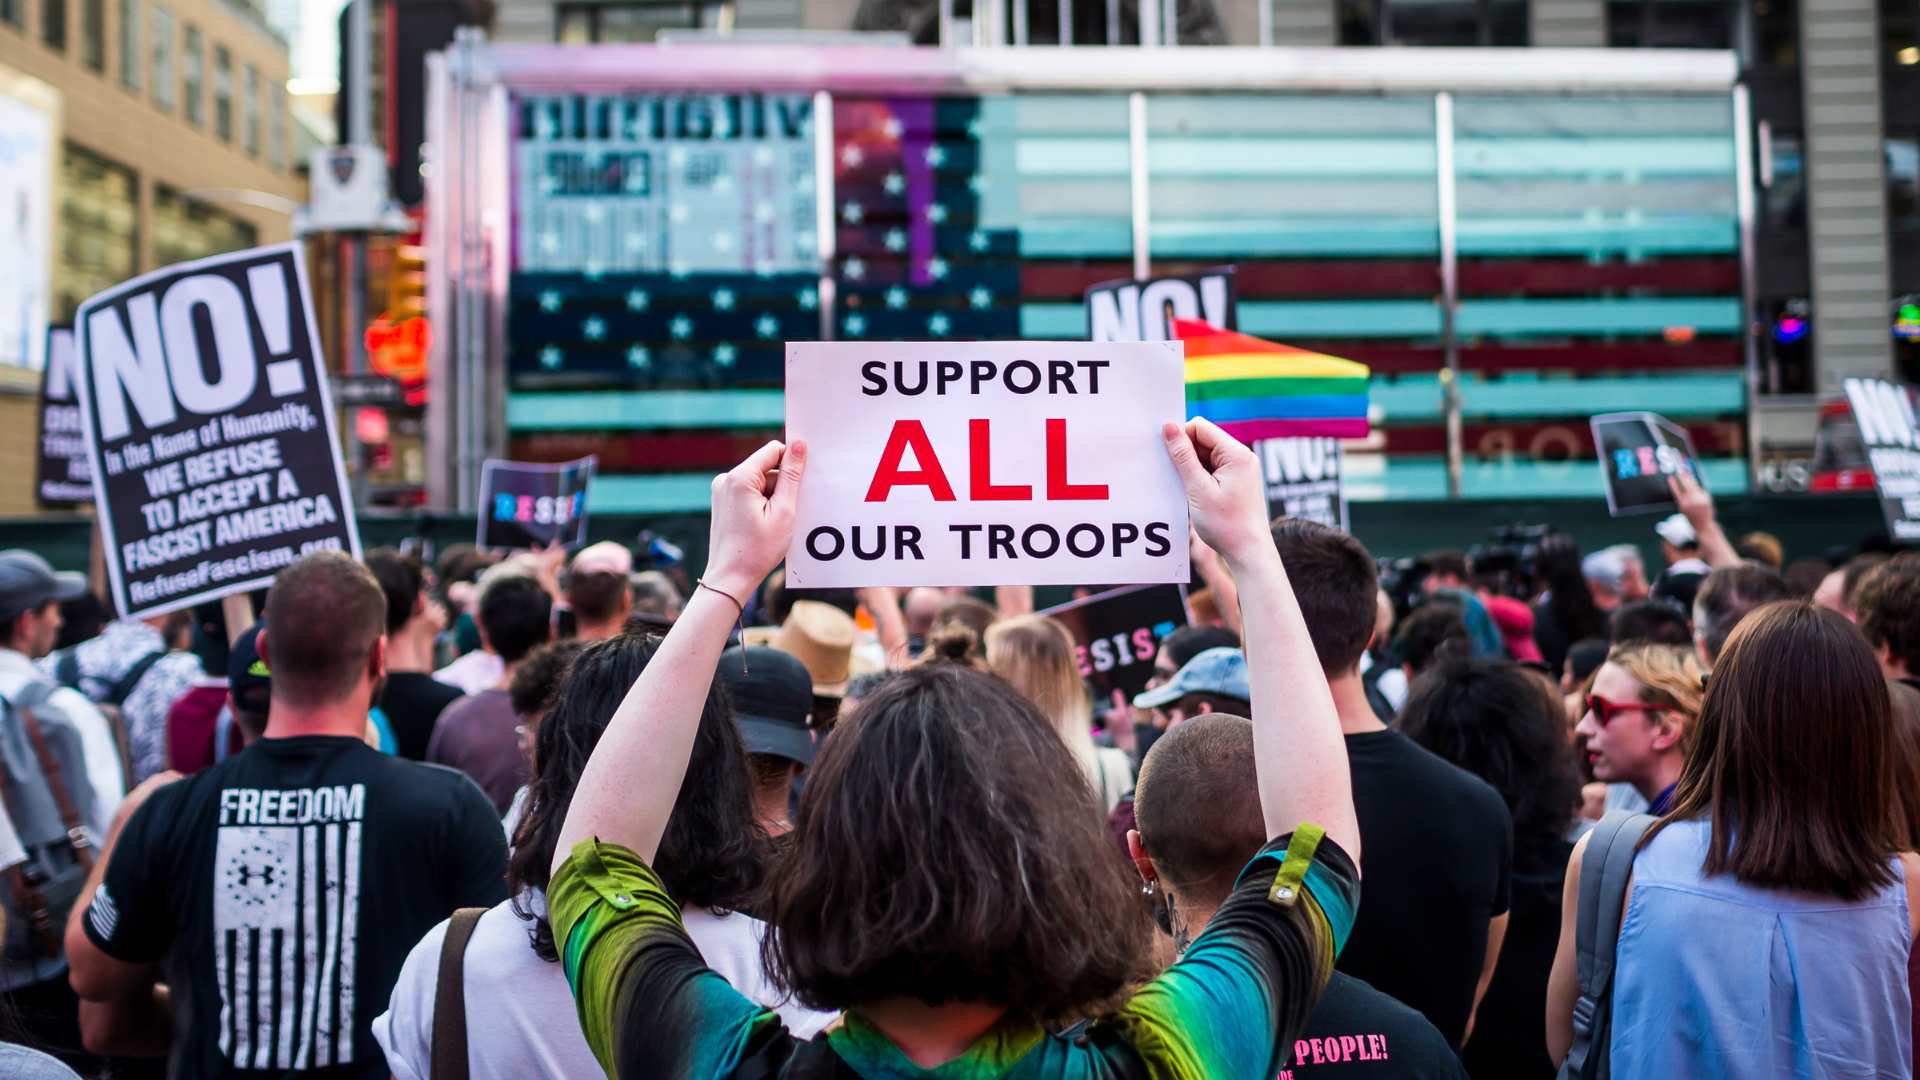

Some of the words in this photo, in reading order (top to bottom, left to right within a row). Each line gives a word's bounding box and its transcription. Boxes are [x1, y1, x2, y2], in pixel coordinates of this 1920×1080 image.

[88, 262, 306, 441] NO!
[861, 359, 1110, 396] SUPPORT
[122, 442, 151, 470] the
[152, 429, 199, 460] Name
[200, 415, 221, 447] of
[143, 462, 186, 498] WE
[184, 438, 283, 487] REFUSE
[864, 418, 1109, 502] ALL
[141, 499, 177, 532] TO
[178, 474, 271, 523] ACCEPT
[276, 467, 300, 498] A
[123, 520, 213, 573] FASCIST
[215, 494, 338, 547] AMERICA
[805, 525, 925, 561] OUR
[949, 521, 1172, 560] TROOPS
[219, 783, 366, 825] FREEDOM
[1294, 1034, 1389, 1066] PEOPLE!
